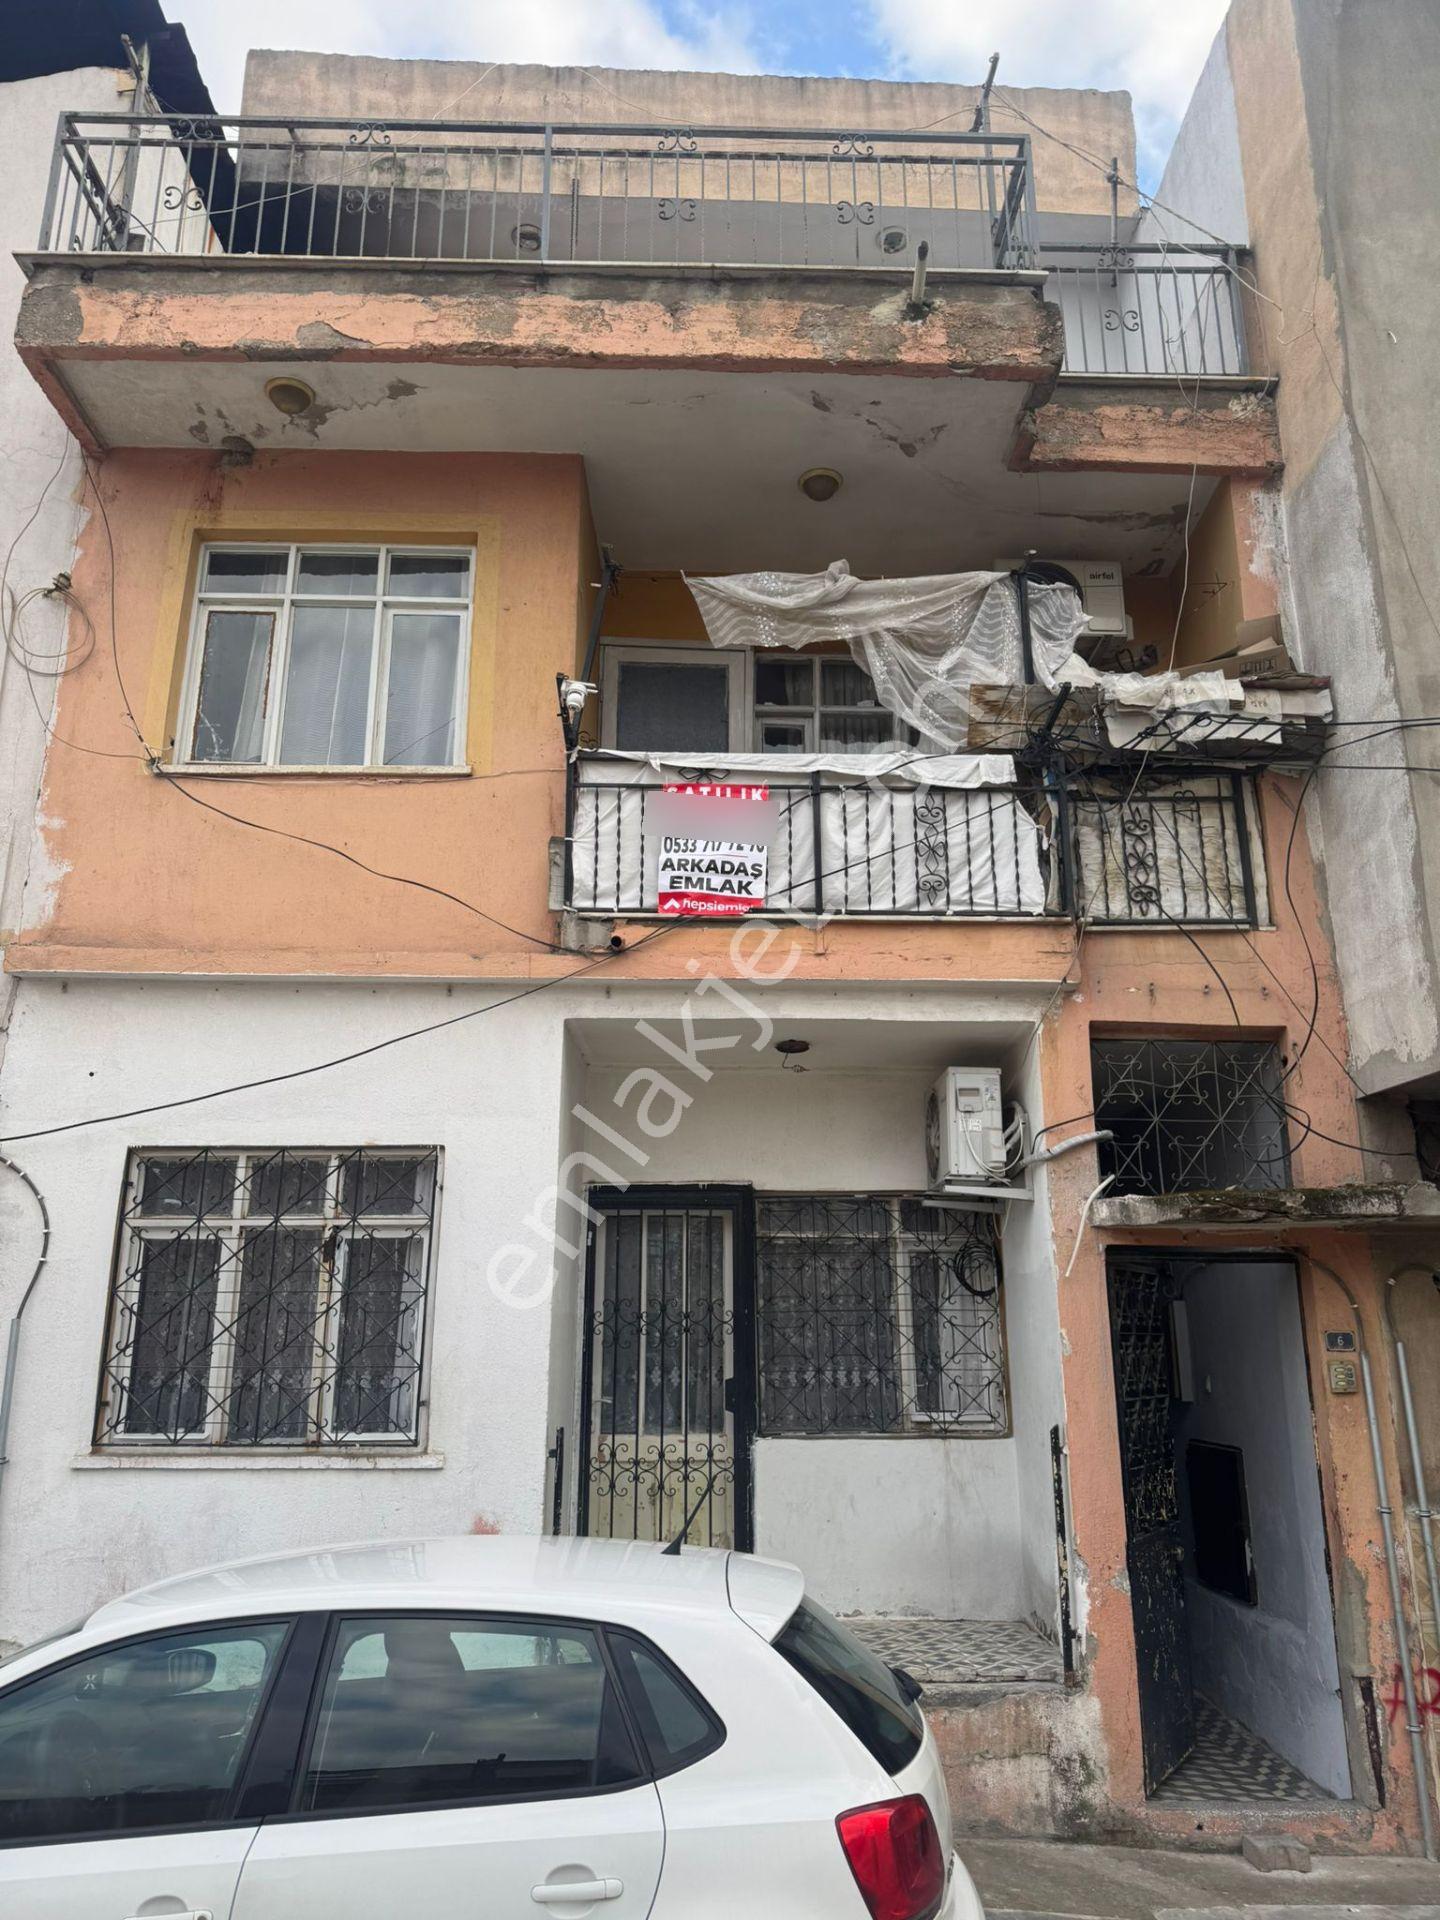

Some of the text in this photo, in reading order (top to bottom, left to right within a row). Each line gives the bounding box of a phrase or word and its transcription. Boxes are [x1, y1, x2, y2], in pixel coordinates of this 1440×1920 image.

[664, 836, 697, 854] 0533
[661, 857, 763, 880] ARKADAŞ
[669, 875, 753, 896] EMLAK
[682, 897, 753, 913] hepsiemla
